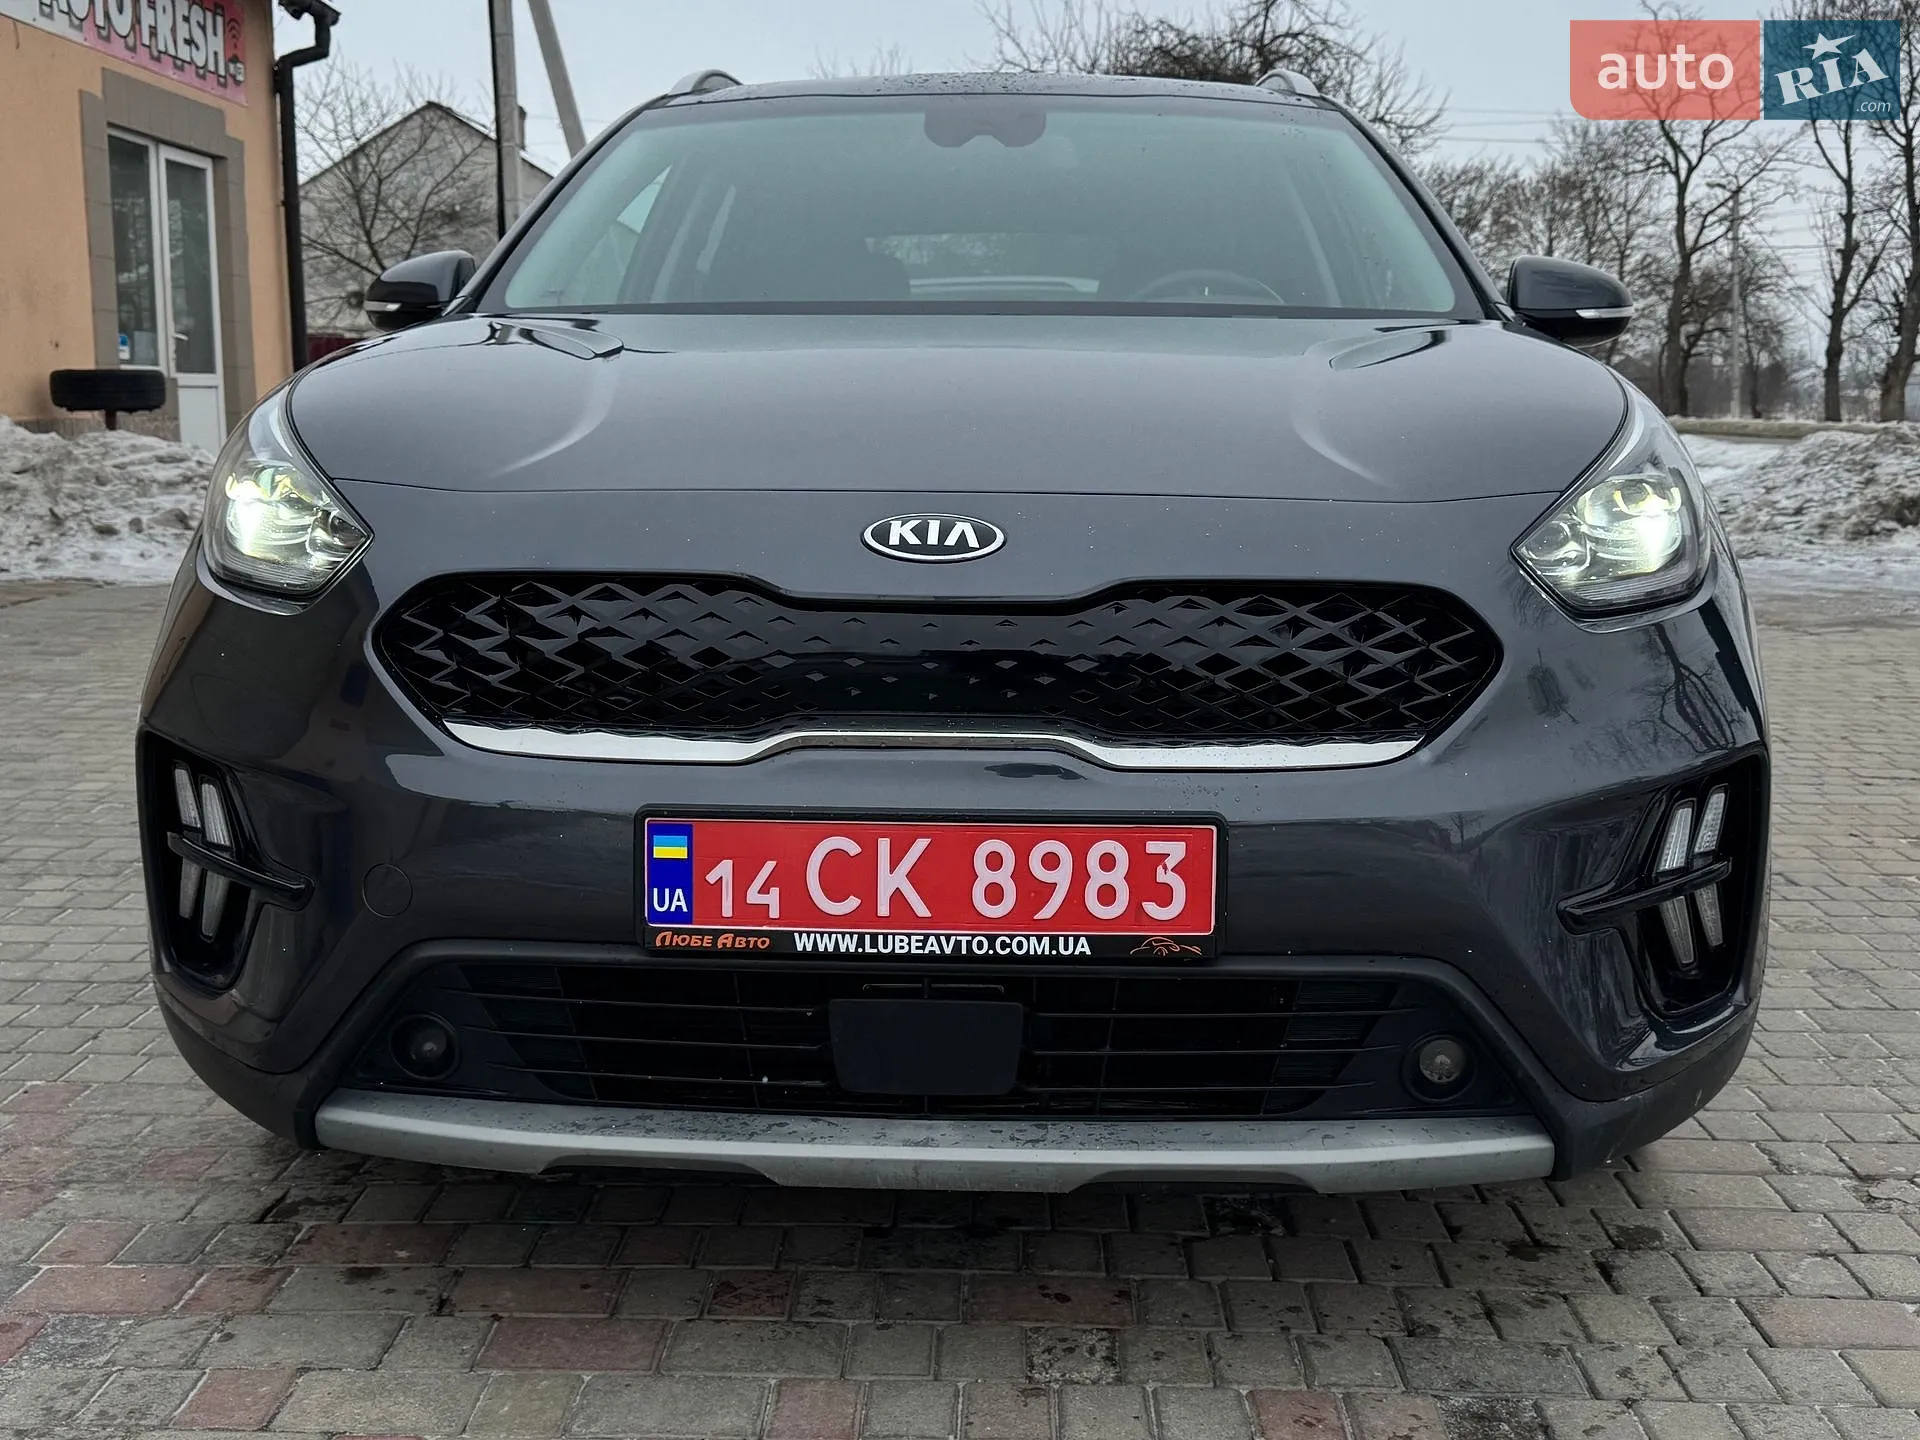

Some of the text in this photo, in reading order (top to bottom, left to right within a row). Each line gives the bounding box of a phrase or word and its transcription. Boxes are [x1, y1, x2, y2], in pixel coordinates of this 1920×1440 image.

[141, 0, 227, 78] FRESH
[888, 519, 980, 549] KIA
[705, 836, 1187, 921] 14 CK 8983
[653, 888, 688, 912] UA
[794, 932, 1092, 956] WWW.LUBEAVTO.COM.UA
